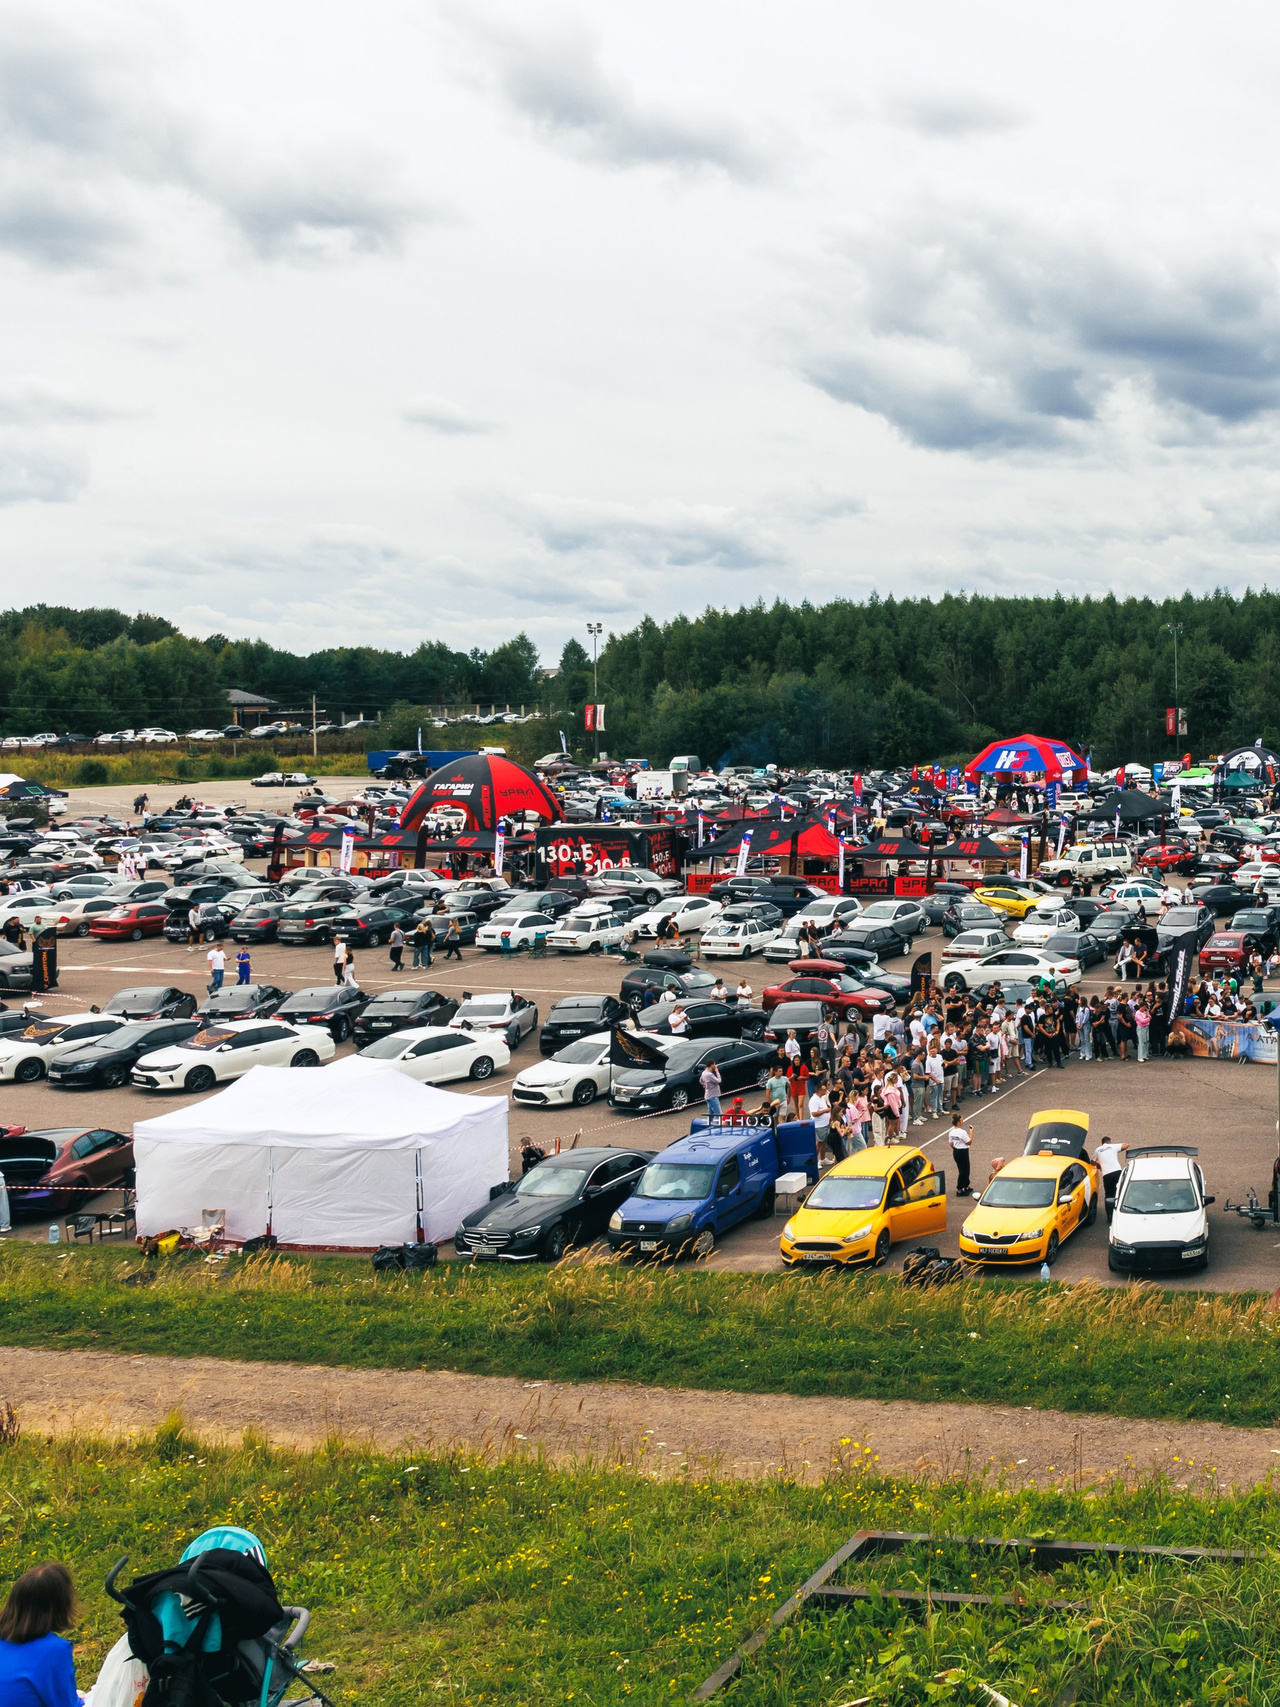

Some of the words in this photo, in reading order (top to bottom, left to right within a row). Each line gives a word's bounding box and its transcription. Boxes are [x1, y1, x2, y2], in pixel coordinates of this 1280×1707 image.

[500, 789, 534, 797] УРАЛ
[537, 844, 594, 863] 130дБ
[850, 879, 888, 887] УРАЛ
